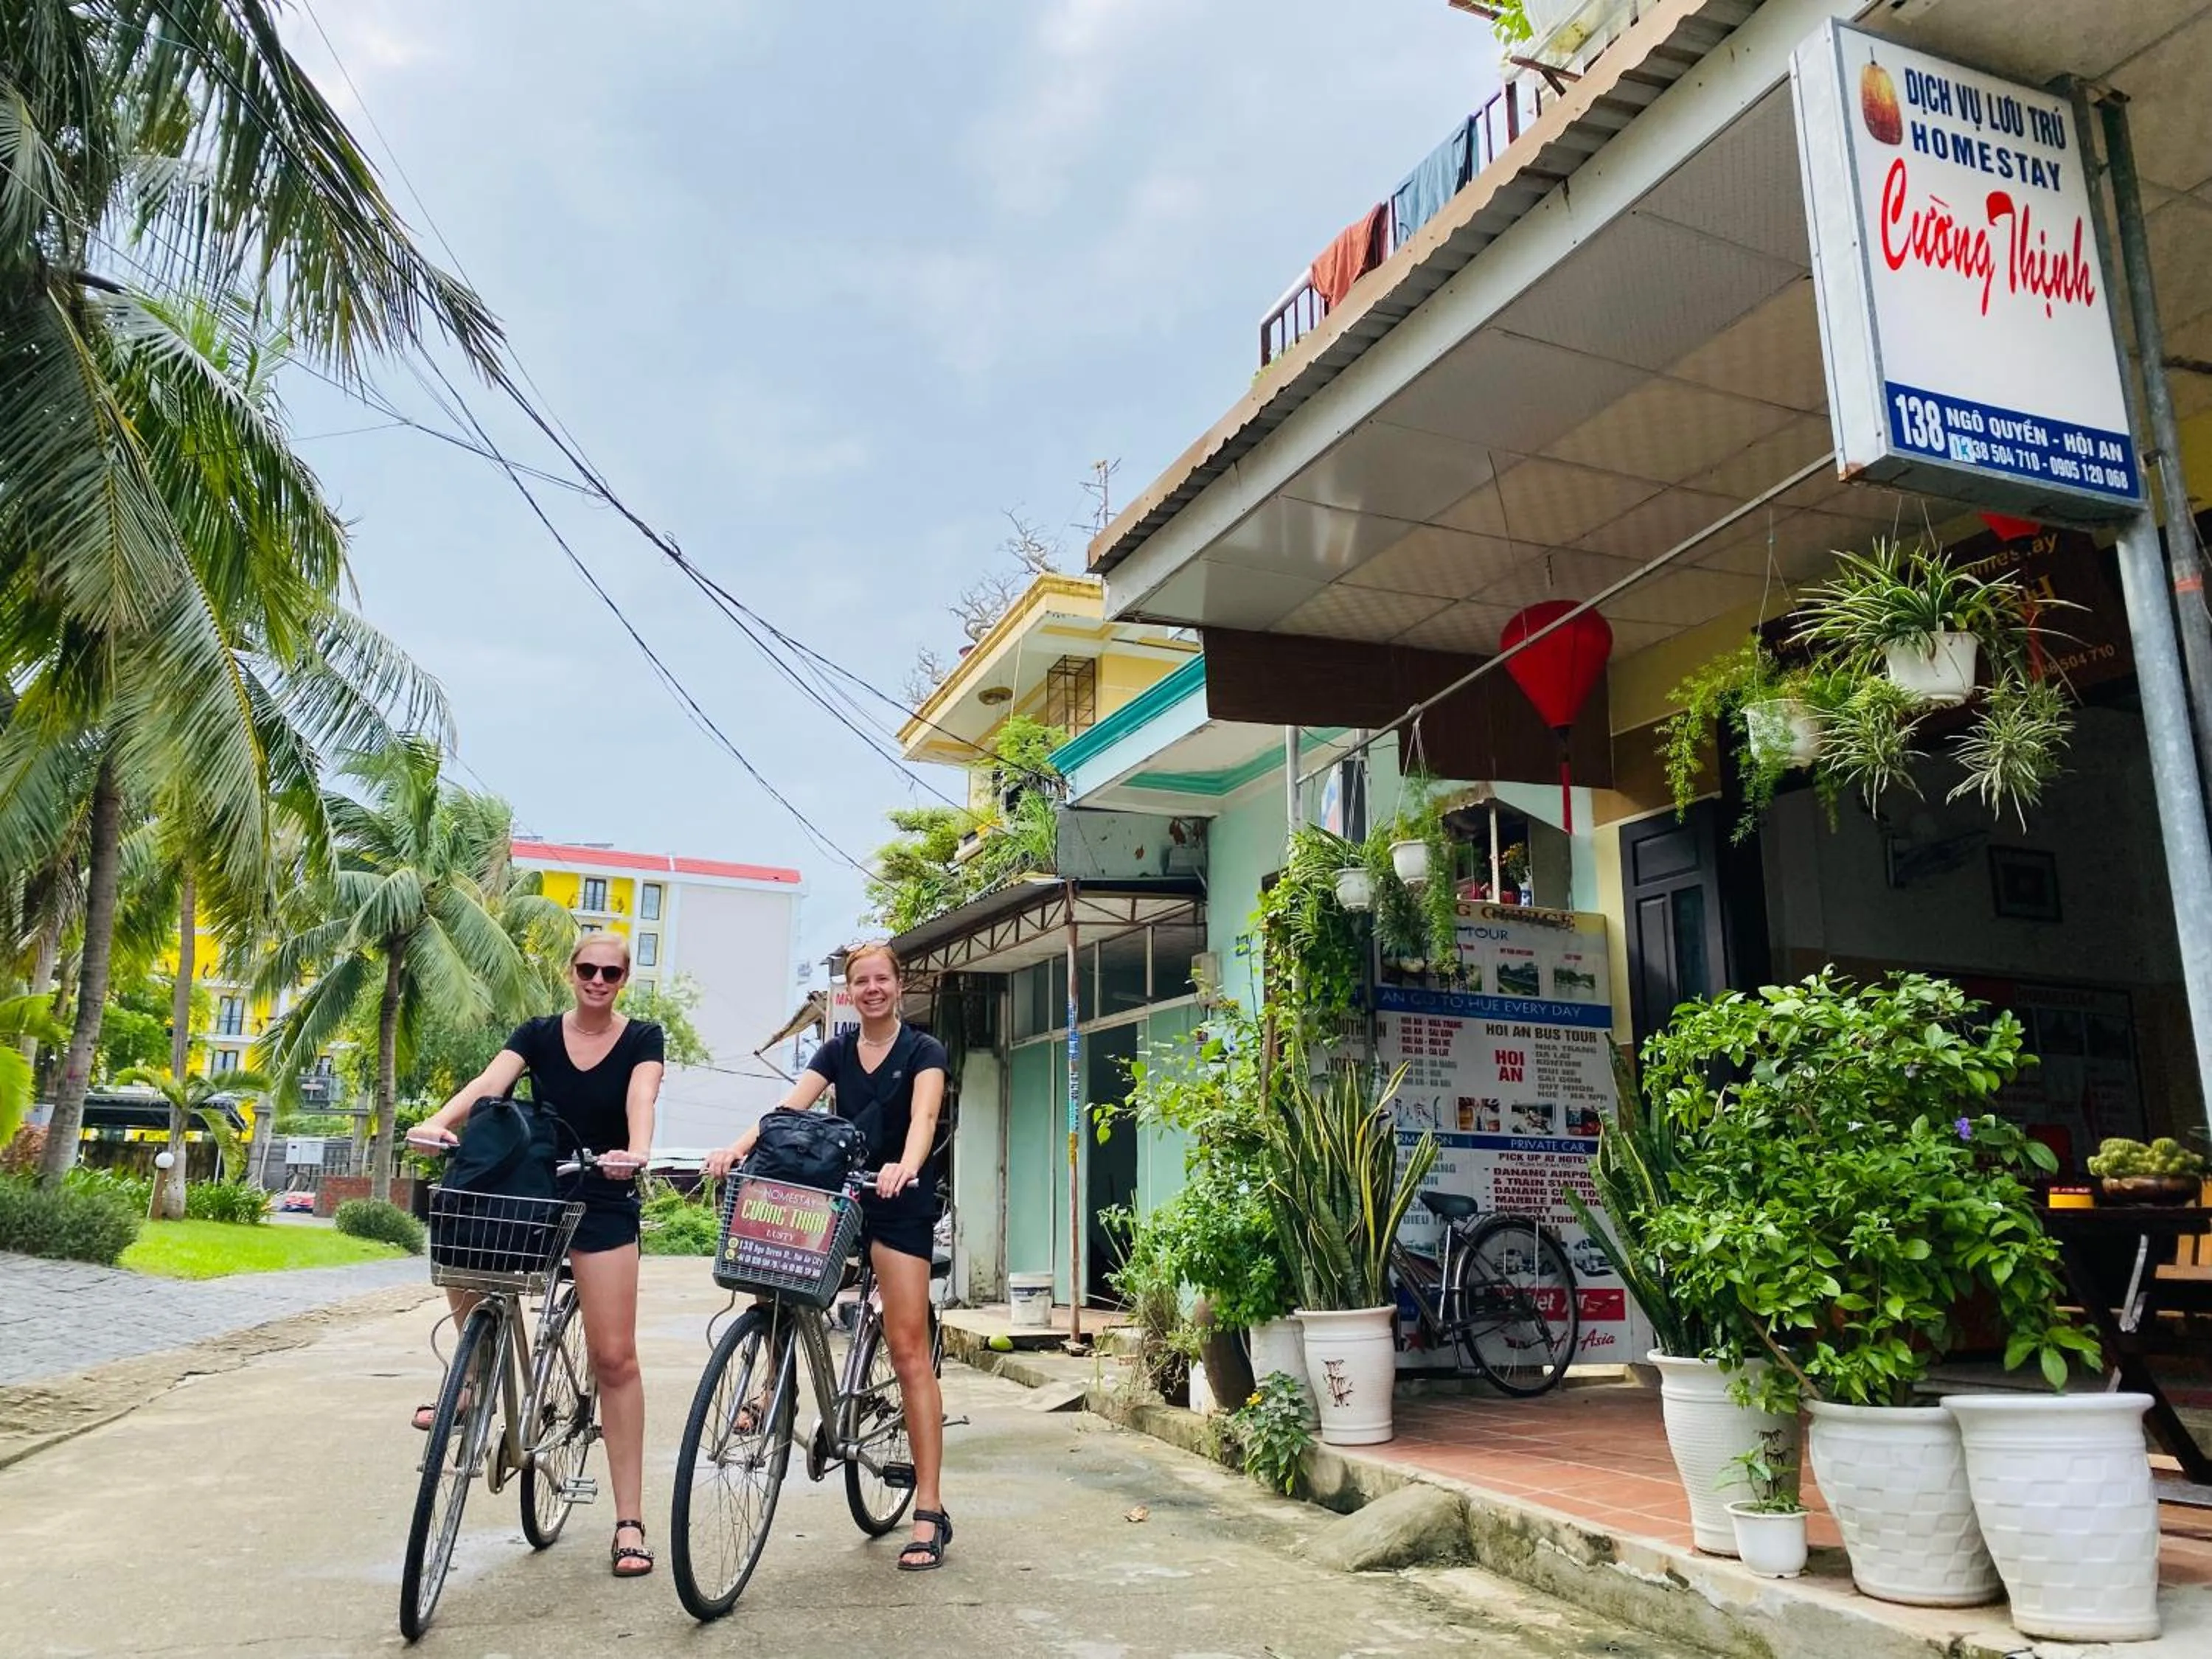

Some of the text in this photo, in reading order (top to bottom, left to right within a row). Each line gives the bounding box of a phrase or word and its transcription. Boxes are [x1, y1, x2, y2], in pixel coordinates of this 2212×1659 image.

[1905, 67, 1952, 116] DỊCH
[1955, 83, 1983, 131] VỤ
[1910, 120, 2061, 192] HOMESTAY
[1881, 158, 2096, 319] Cường Thịnh
[1895, 393, 1945, 452] 138
[1945, 407, 1985, 434] NGÔ
[2063, 431, 2094, 459] HỘI
[2099, 440, 2124, 462] AN
[1990, 443, 2015, 467] 504
[2015, 448, 2040, 471] 710
[2049, 455, 2080, 479] 0905
[2081, 463, 2104, 484] 120
[2105, 467, 2129, 490] 068
[1466, 925, 1509, 940] TOUR
[1382, 992, 1405, 1004] AN
[1442, 995, 1464, 1008] TO
[1468, 997, 1499, 1012] HUE
[1504, 1001, 1547, 1015] EVERY
[1552, 1005, 1581, 1018] DAY
[1486, 1023, 1597, 1043] HOI AN BUS TOUR
[1495, 1049, 1525, 1066] HOI
[1498, 1067, 1523, 1082] AN
[1511, 1138, 1586, 1152] PRIVATE CAR
[1498, 1152, 1524, 1161] PICK
[1527, 1154, 1541, 1162] UP
[1493, 1167, 1546, 1177] DANANG
[1506, 1178, 1545, 1186] TRAIN
[762, 1188, 816, 1207] HOMESTAY
[1495, 1187, 1547, 1196] DANANG
[1495, 1196, 1548, 1205] MARBLE
